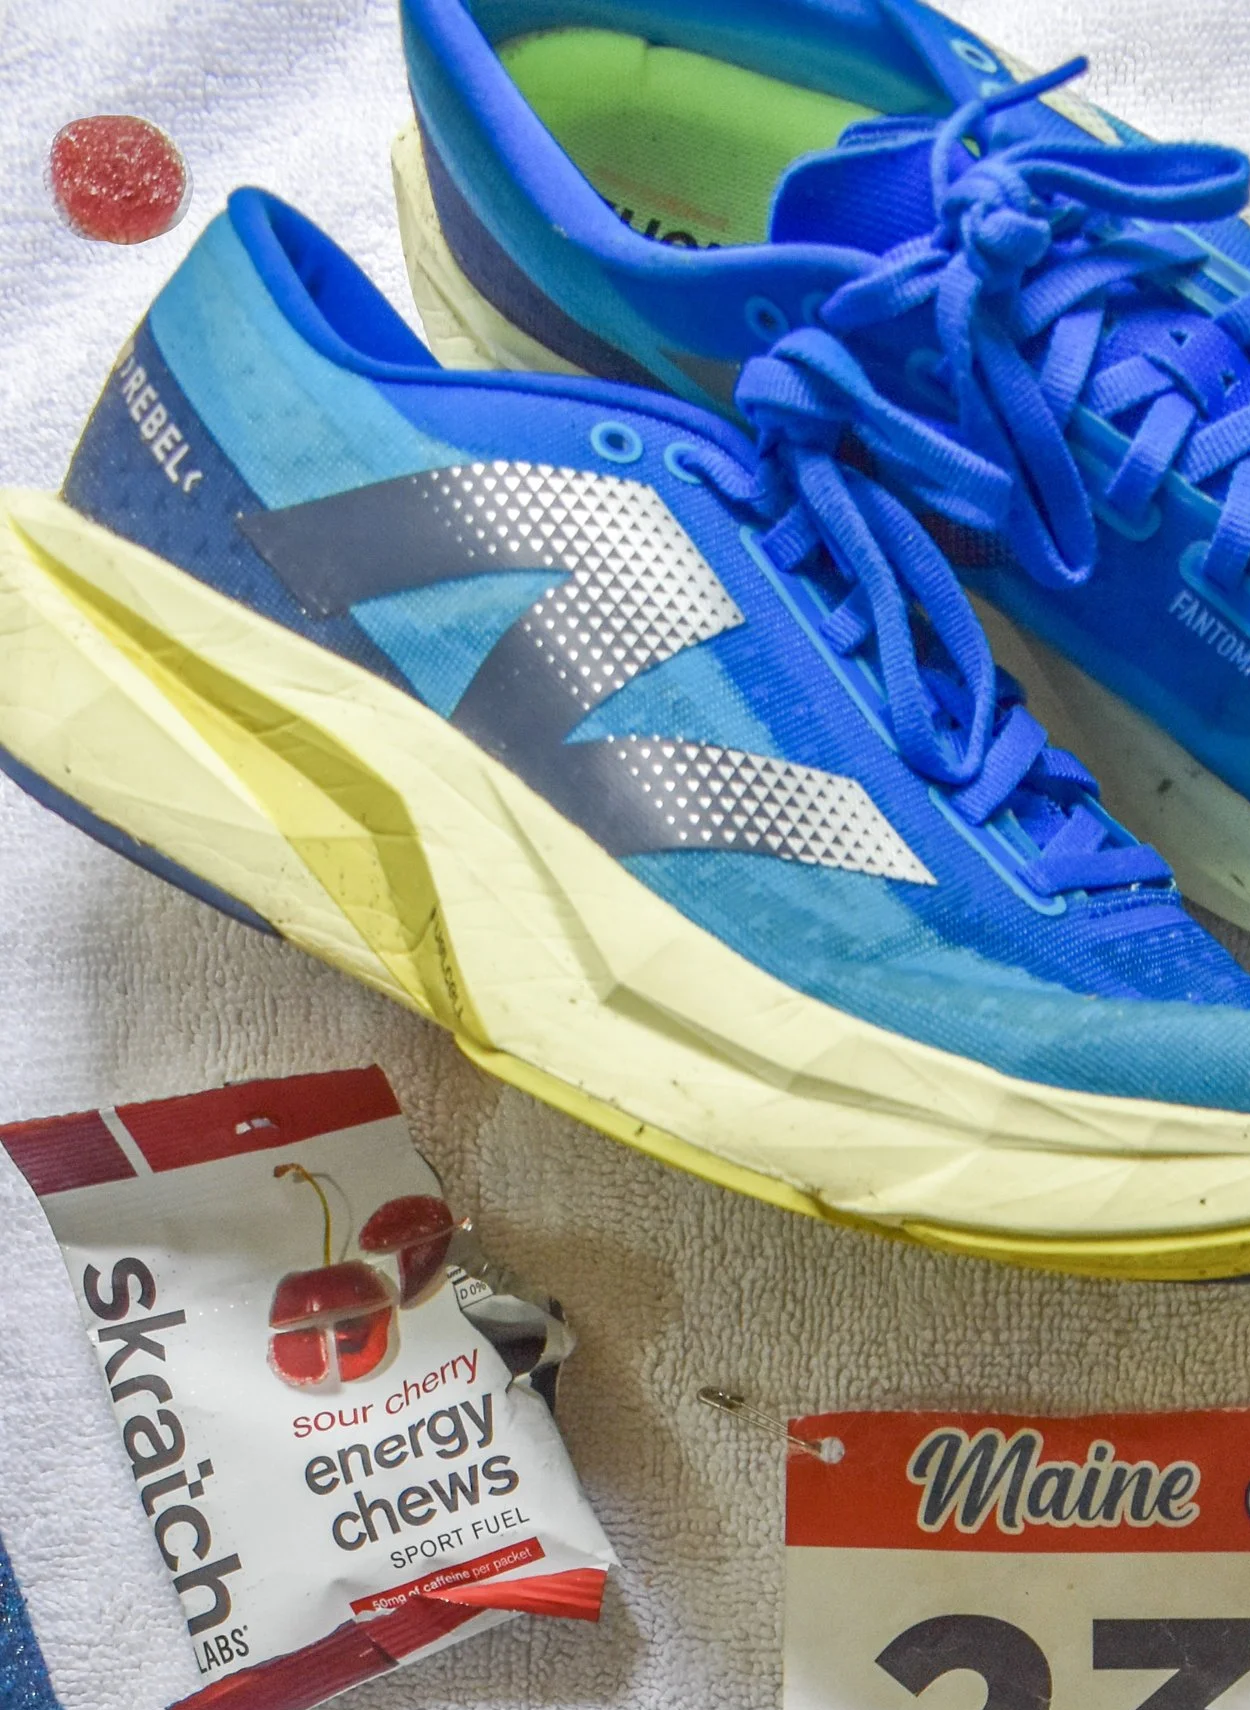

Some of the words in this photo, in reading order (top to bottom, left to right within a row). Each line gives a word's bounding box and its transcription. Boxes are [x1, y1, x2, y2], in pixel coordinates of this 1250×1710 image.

[292, 1403, 374, 1439] sour
[384, 1348, 478, 1415] cherry
[83, 1256, 243, 1636] skratch
[304, 1393, 494, 1496] energy
[908, 1429, 1199, 1533] Maine
[332, 1455, 520, 1552] chews
[389, 1527, 467, 1569] SPORT
[470, 1506, 531, 1541] FUEL
[371, 1592, 408, 1610] 50mg
[423, 1569, 471, 1593] caffeine
[471, 1563, 492, 1579] per
[492, 1547, 533, 1572] packet
